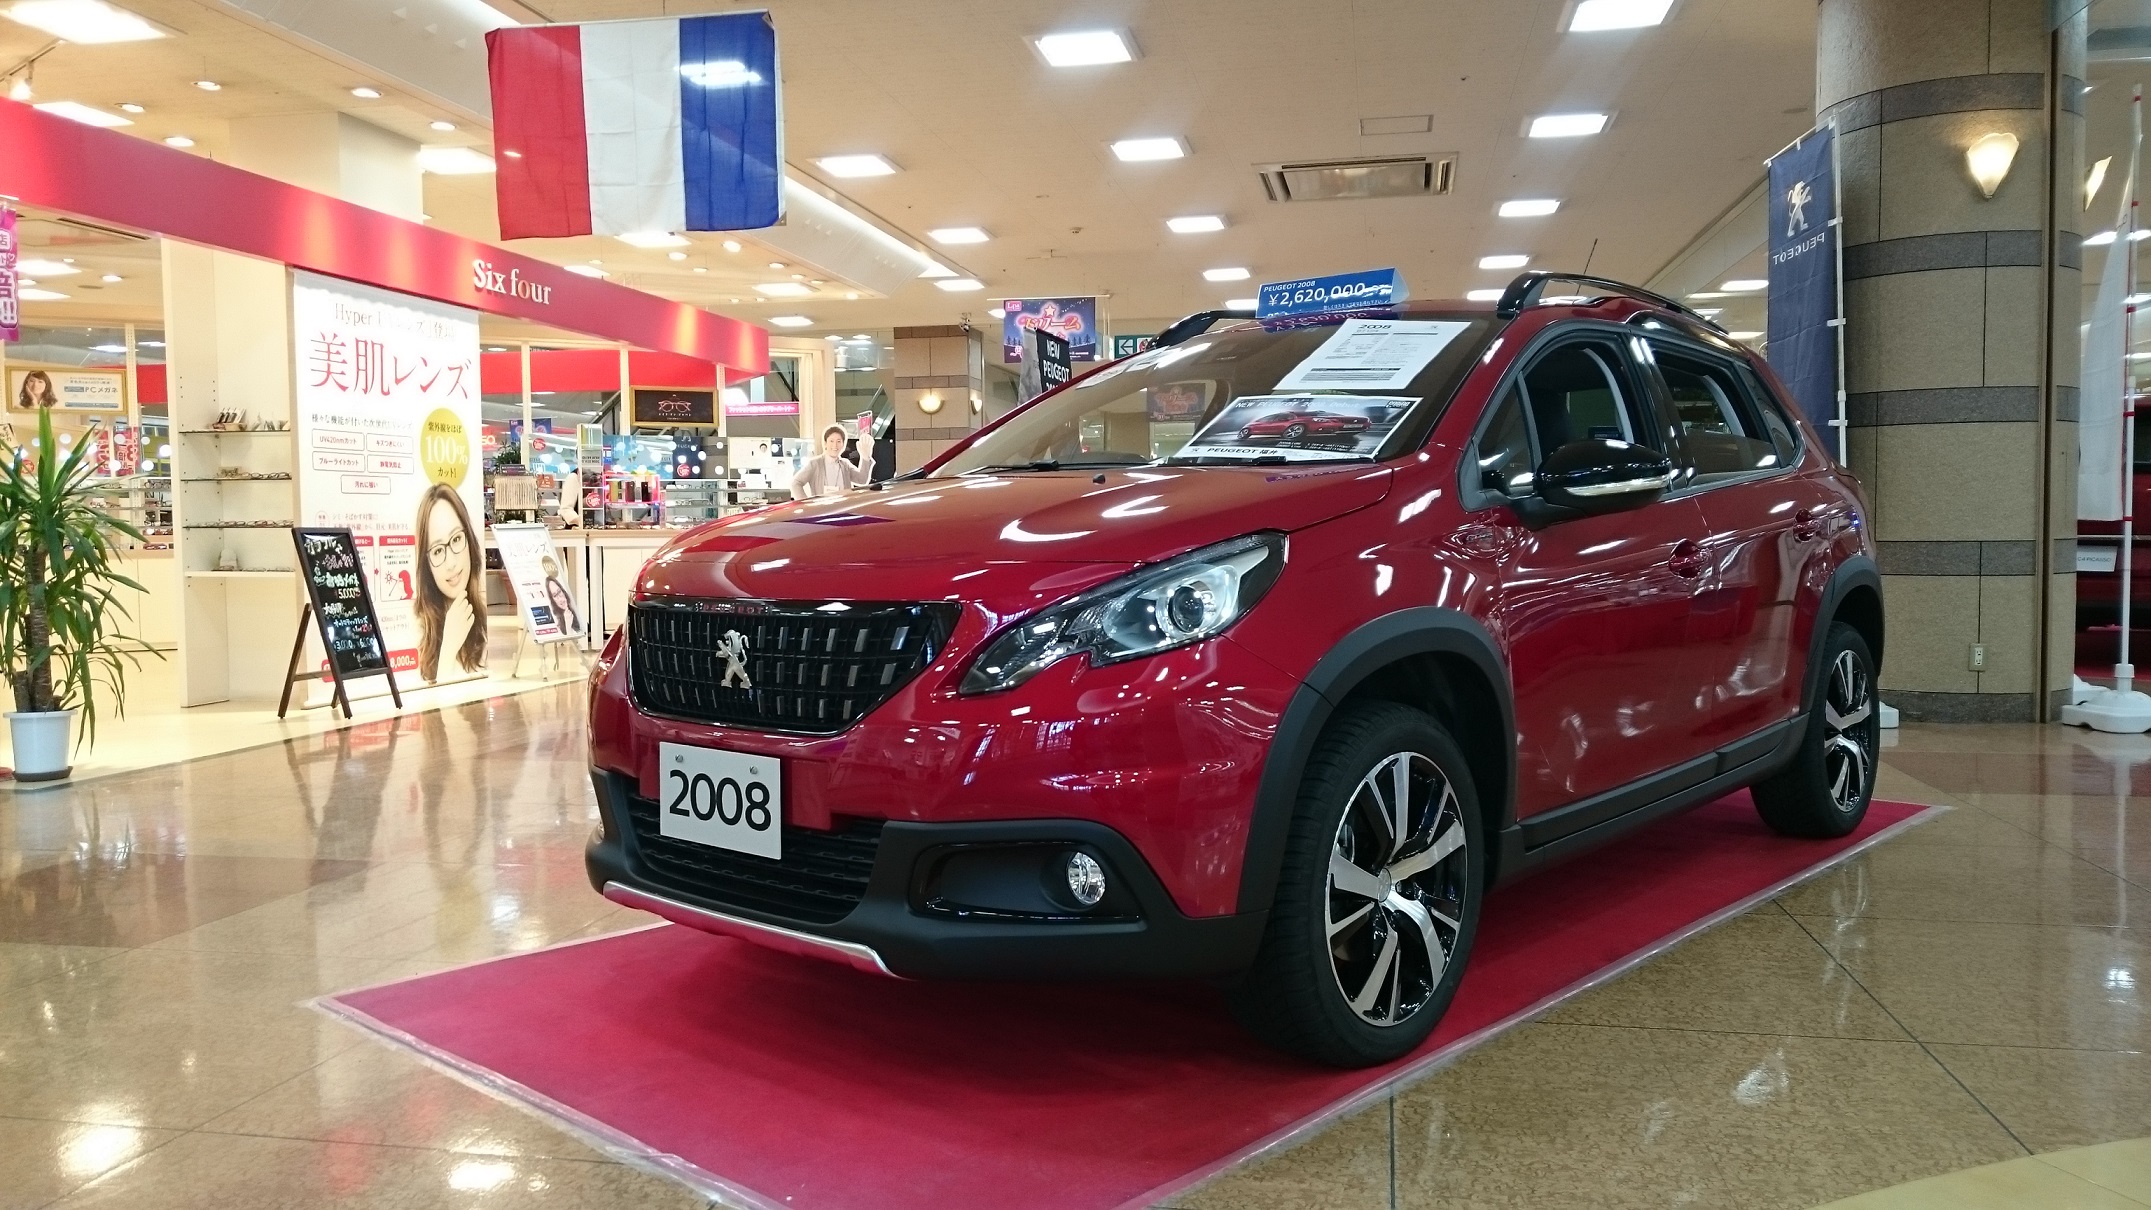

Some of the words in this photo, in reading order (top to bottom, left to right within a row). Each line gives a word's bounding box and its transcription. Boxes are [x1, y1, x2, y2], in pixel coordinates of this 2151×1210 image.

[472, 259, 507, 294] Six
[510, 268, 552, 305] four
[1263, 282, 1297, 292] PEUGEOT
[334, 302, 373, 327] Hyper
[1046, 339, 1060, 360] NEW
[309, 331, 472, 400] 美肌レンズ
[1043, 361, 1070, 383] PEUGEOT
[425, 434, 468, 465] 100%
[1207, 447, 1257, 455] PEUGEOT
[669, 769, 772, 832] 2008
